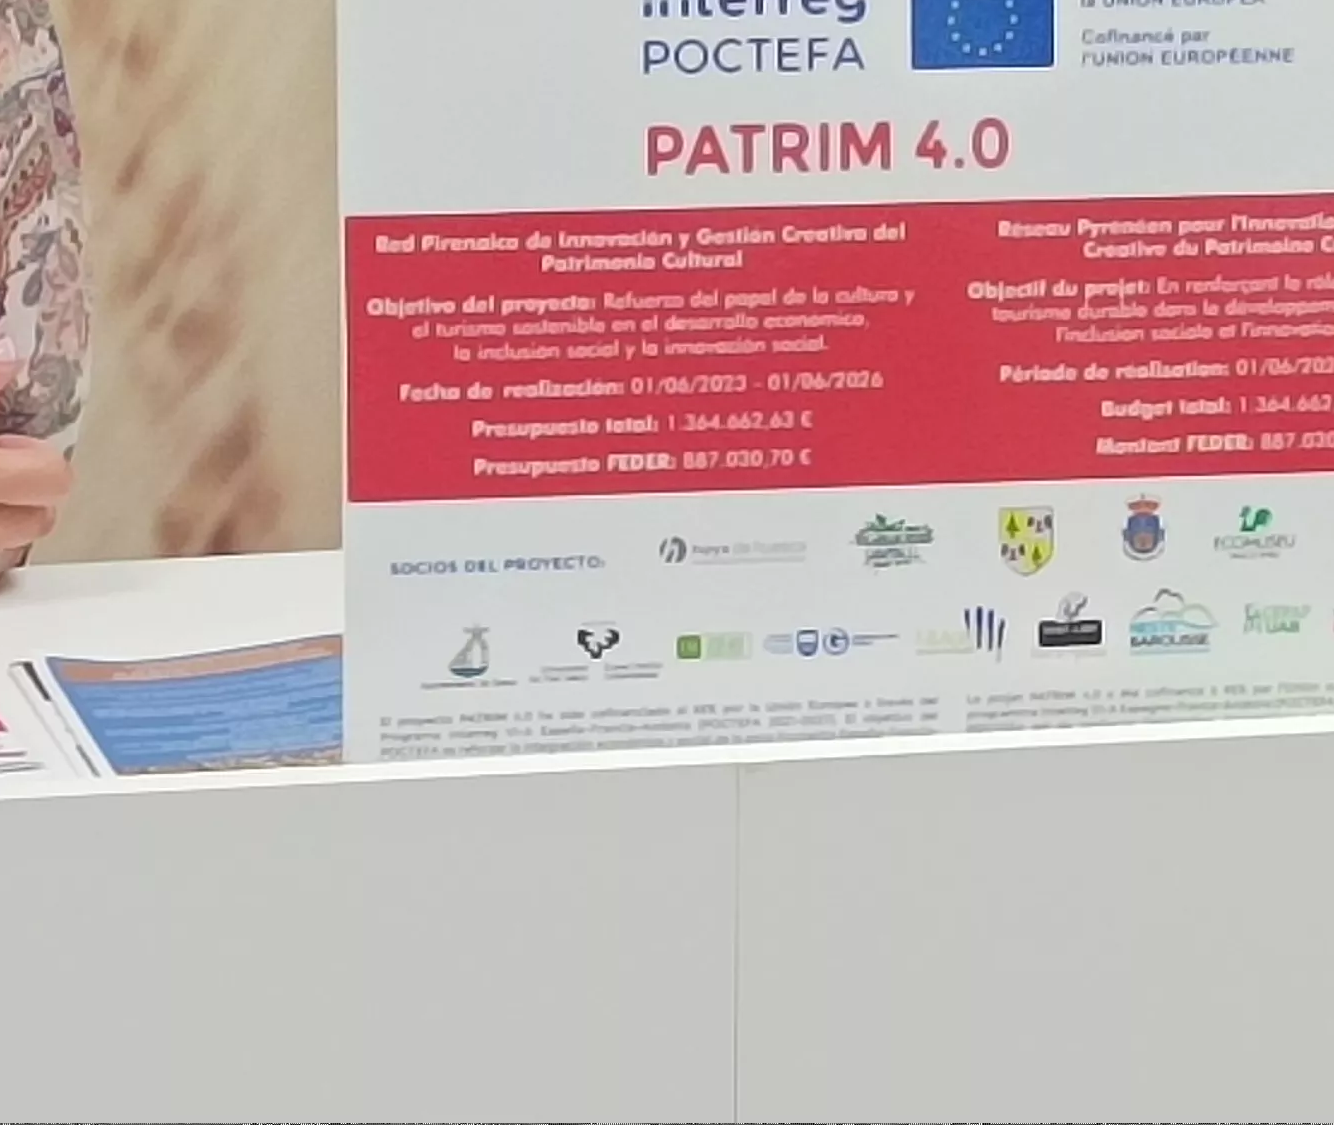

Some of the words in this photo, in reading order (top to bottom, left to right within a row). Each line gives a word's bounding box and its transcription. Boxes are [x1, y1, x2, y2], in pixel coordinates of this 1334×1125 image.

[1082, 27, 1174, 45] Cofinancé
[1181, 31, 1210, 46] par
[643, 38, 864, 74] POCTEFA
[1161, 47, 1294, 65] EUROPÉENNE
[648, 121, 891, 176] PATRIM
[915, 118, 1009, 169] 4.0
[376, 235, 415, 252] Red
[422, 233, 518, 251] Pirenaica
[525, 231, 552, 250] de
[559, 231, 672, 248] Innovación
[679, 234, 689, 249] y
[696, 227, 775, 245] Gestión
[782, 225, 867, 242] Creativa
[874, 222, 905, 240] del
[1178, 219, 1225, 236] pour
[1173, 239, 1198, 255] du
[1205, 237, 1314, 255] Patrimoine
[542, 253, 655, 271] Patrimonio
[662, 250, 742, 269] Cultural
[968, 279, 1046, 302] Objectif
[1052, 279, 1078, 296] du
[1083, 279, 1150, 305] projet:
[1157, 277, 1179, 294] En
[1284, 274, 1301, 291] le
[367, 298, 455, 319] Objetivo
[462, 296, 494, 313] del
[501, 295, 595, 315] proyecto:
[690, 290, 718, 308] del
[725, 289, 777, 309] papel
[782, 288, 806, 305] de
[813, 287, 829, 304] la
[835, 286, 898, 303] cultura
[905, 291, 915, 305] y
[992, 303, 1071, 322] tourisme
[1078, 302, 1148, 320] durable
[1203, 299, 1219, 315] le
[412, 321, 429, 338] el
[436, 323, 506, 337] turismo
[513, 317, 605, 335] sostenible
[611, 320, 636, 332] en
[641, 315, 658, 331] el
[664, 313, 758, 331] desarrollo
[1151, 323, 1213, 341] sociale
[1218, 325, 1236, 338] et
[454, 345, 471, 361] la
[567, 339, 619, 358] social
[625, 345, 636, 360] y
[642, 340, 658, 356] la
[1000, 364, 1077, 382] Période
[1084, 363, 1109, 380] de
[400, 383, 460, 401] Fecha
[467, 382, 492, 399] de
[503, 380, 624, 397] realización:
[1102, 400, 1173, 420] Budget
[1179, 397, 1230, 414] total:
[472, 419, 599, 439] Presupuesto
[606, 415, 658, 433] total:
[801, 411, 812, 427] €
[1096, 438, 1180, 454] Montant
[1187, 434, 1253, 451] FEDER:
[474, 458, 600, 478] Presupuesto
[607, 453, 675, 471] FEDER:
[799, 449, 811, 465] €
[390, 560, 458, 575] SOCIOS
[464, 560, 498, 573] DEL
[503, 555, 605, 571] PROYECTO:
